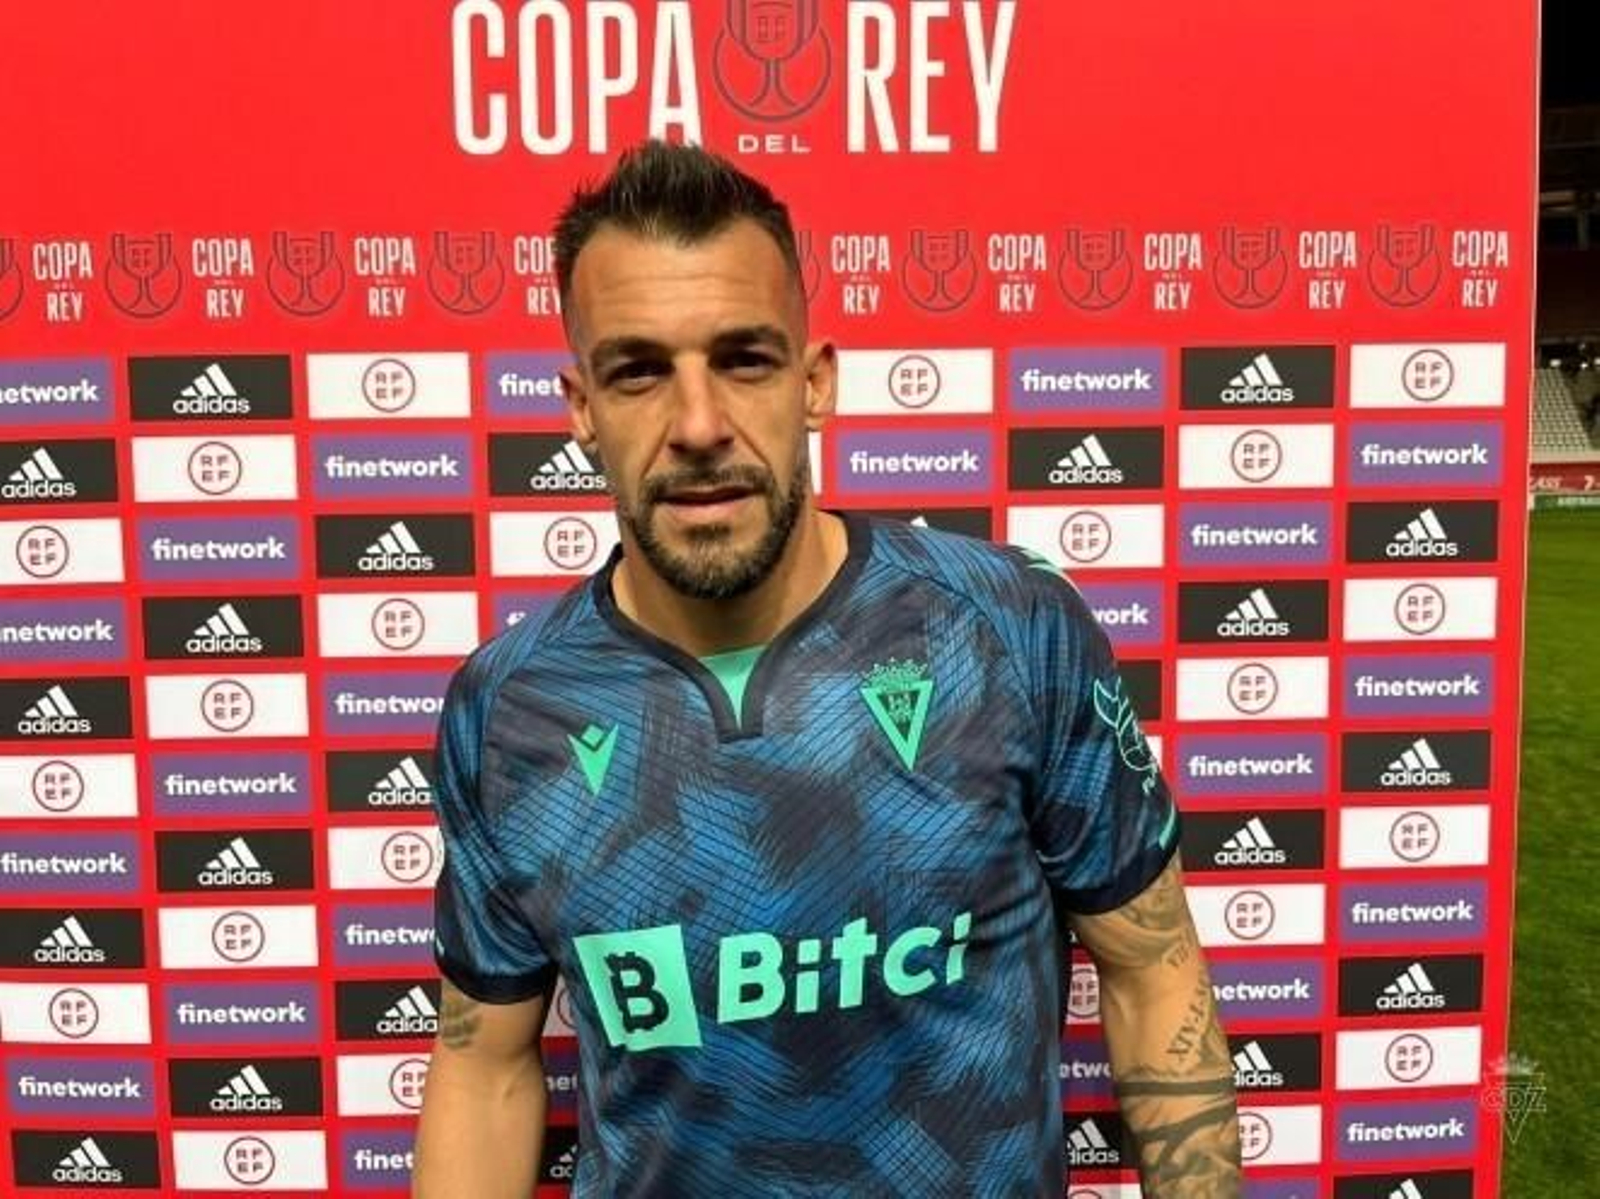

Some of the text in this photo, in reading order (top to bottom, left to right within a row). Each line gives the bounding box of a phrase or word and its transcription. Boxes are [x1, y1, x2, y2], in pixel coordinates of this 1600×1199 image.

[452, 0, 1016, 155] COPA DEL REY
[192, 238, 254, 277] COPA
[354, 237, 416, 276] COPA
[831, 234, 890, 273] COPA
[988, 233, 1047, 272] COPA
[1144, 232, 1203, 271] COPA
[1298, 230, 1357, 269] COPA
[1452, 230, 1509, 268] COPA
[33, 241, 93, 281] COPA
[206, 288, 244, 318] REY
[368, 287, 406, 317] REY
[843, 283, 880, 314] REY
[999, 283, 1036, 312] REY
[1154, 281, 1191, 310] REY
[1308, 279, 1346, 309] REY
[1462, 278, 1499, 307] REY
[47, 292, 83, 322] REY
[1022, 369, 1150, 391] finetwork
[1221, 382, 1294, 402] adidas
[173, 395, 250, 413] adidas
[850, 450, 977, 472] finetwork
[1362, 444, 1487, 464] finetwork
[326, 455, 457, 477] finetwork
[1049, 463, 1122, 483] adidas
[2, 477, 76, 497] adidas
[531, 470, 606, 489] adidas
[1192, 524, 1316, 545] finetwork
[152, 537, 284, 560] finetwork
[1386, 536, 1458, 556] adidas
[358, 551, 433, 570] adidas
[1217, 616, 1289, 636] adidas
[186, 632, 262, 652] adidas
[1355, 675, 1478, 696] finetwork
[18, 714, 91, 733] adidas
[1189, 754, 1312, 776] finetwork
[1381, 767, 1450, 785] adidas
[165, 773, 296, 795] finetwork
[0, 853, 126, 873] finetwork
[1215, 846, 1285, 864] adidas
[199, 866, 272, 885] adidas
[1352, 901, 1472, 922] finetwork
[35, 943, 105, 962] adidas
[717, 912, 972, 1024] Bitci
[1377, 990, 1445, 1008] adidas
[178, 1002, 304, 1023] finetwork
[19, 1077, 139, 1097] finetwork
[210, 1092, 282, 1110] adidas
[1348, 1119, 1463, 1141] finetwork
[53, 1164, 122, 1182] adidas
